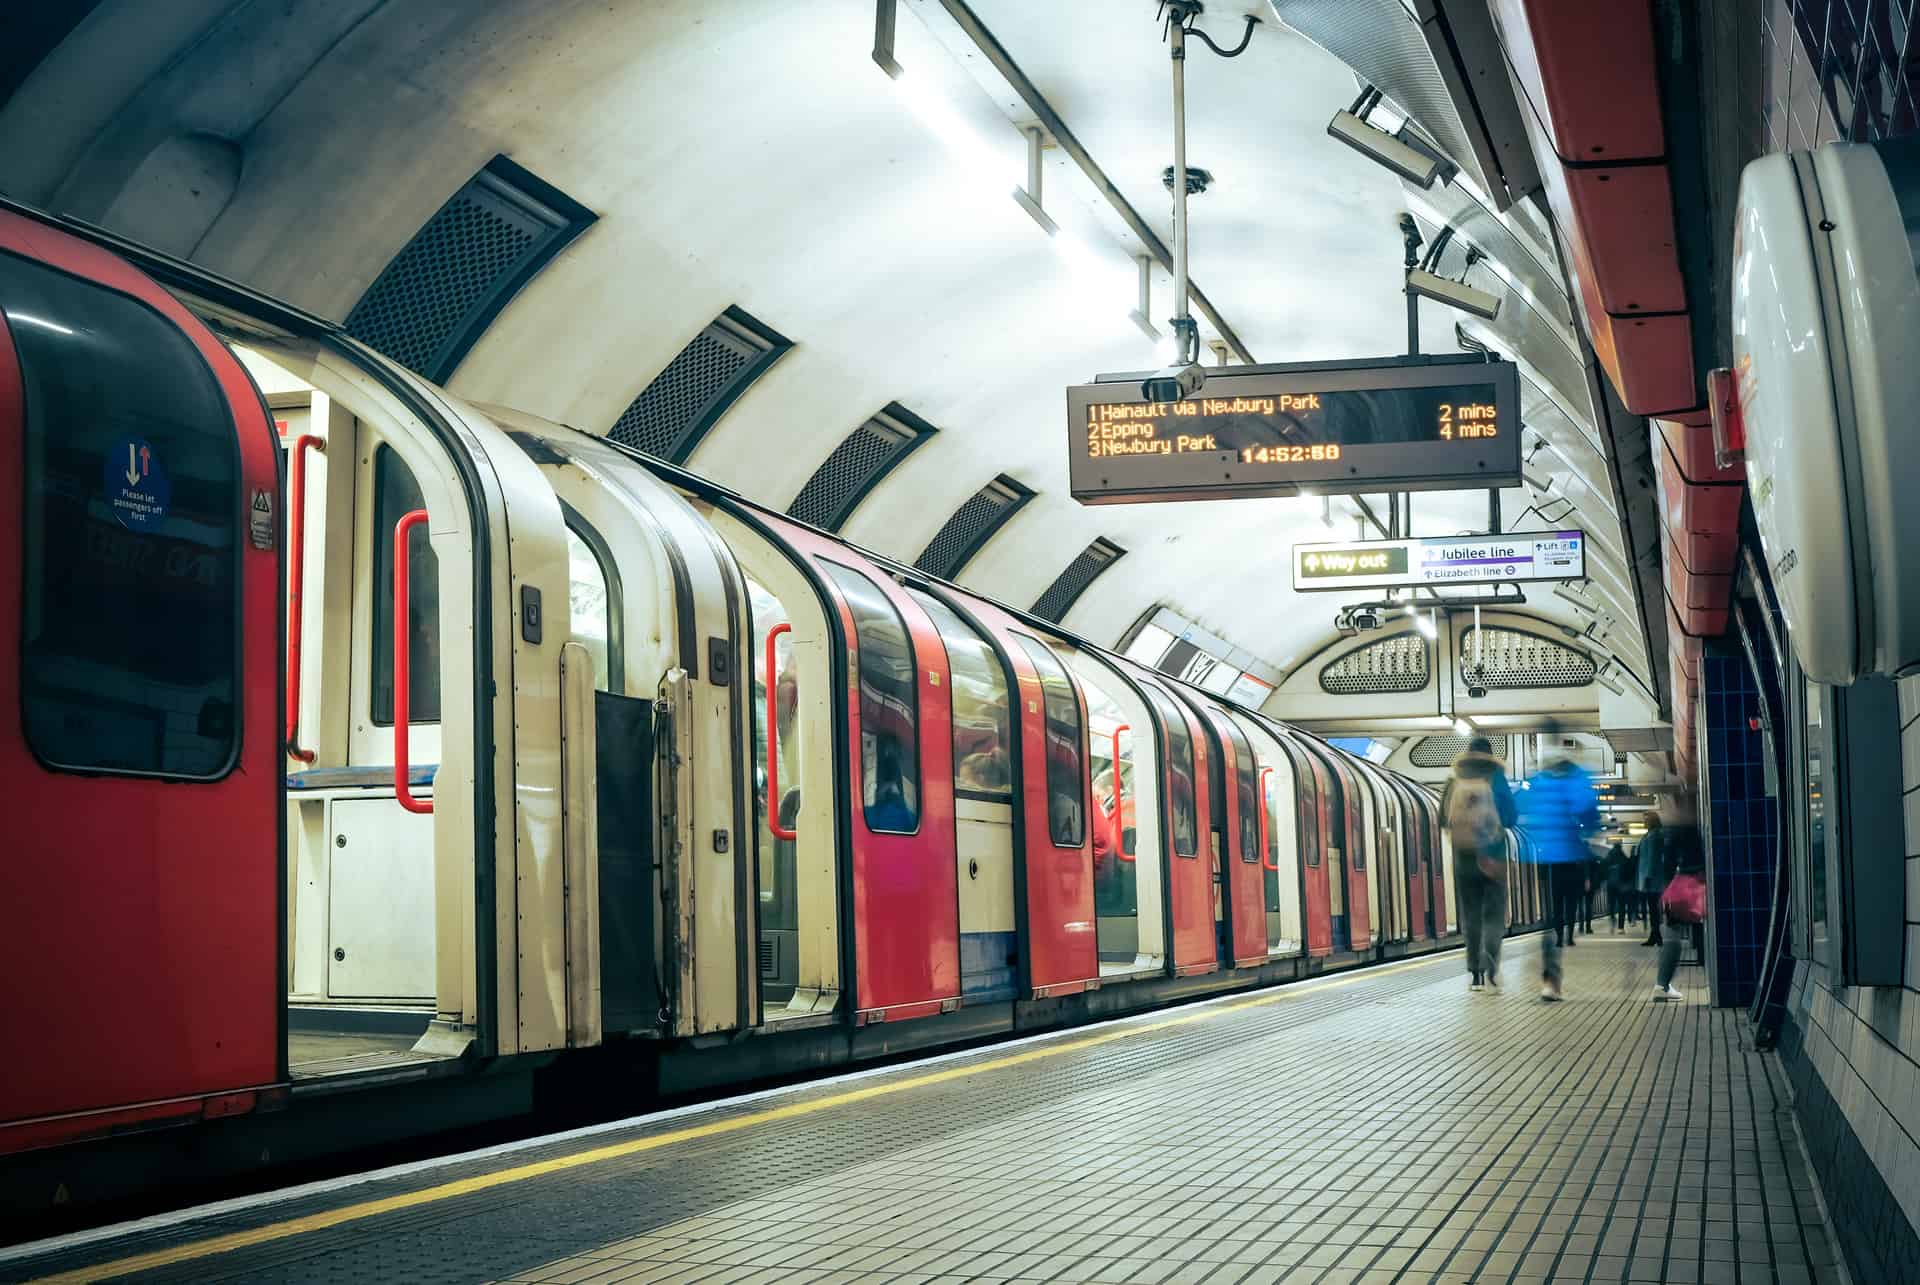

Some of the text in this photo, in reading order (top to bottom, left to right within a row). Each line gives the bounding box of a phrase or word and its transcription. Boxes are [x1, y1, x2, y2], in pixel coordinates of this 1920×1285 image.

[1089, 394, 1496, 421] 1 Hainault via Newbury Park 2 mins
[1088, 421, 1497, 440] 2 Epping 4 mins
[1088, 435, 1216, 457] 3 Newbury Park
[122, 488, 145, 501] Please
[1440, 546, 1515, 561] Jubilee line
[1544, 543, 1559, 551] Lift
[1322, 553, 1388, 572] Way out
[1434, 566, 1501, 578] Elizabeth line
